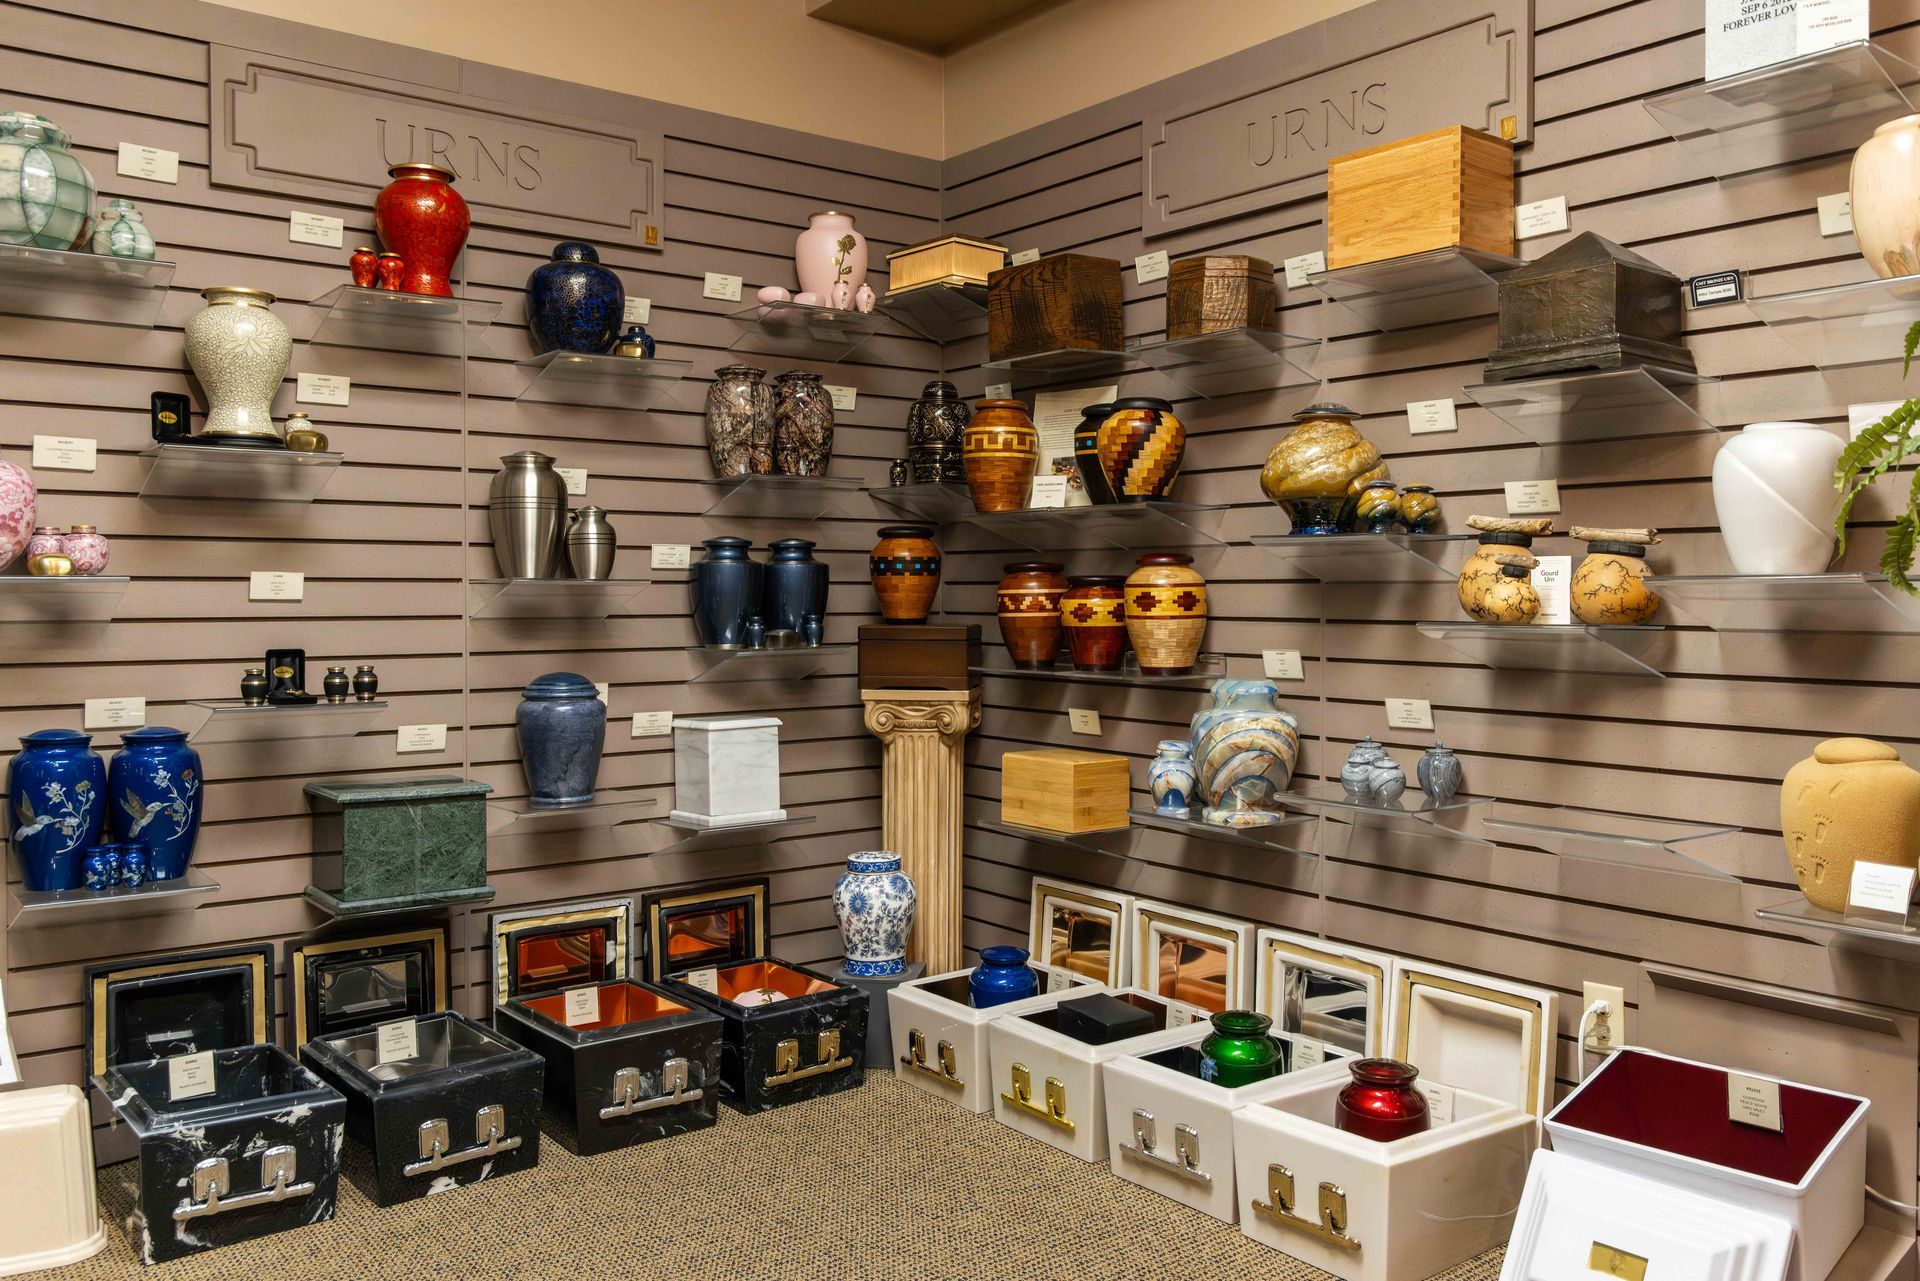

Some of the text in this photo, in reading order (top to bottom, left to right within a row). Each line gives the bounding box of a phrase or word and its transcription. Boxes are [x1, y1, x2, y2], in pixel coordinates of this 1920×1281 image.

[1723, 3, 1798, 32] FOREVER LOV
[1741, 3, 1760, 16] SEP
[1247, 82, 1388, 167] URNS
[375, 118, 543, 191] URNS
[1540, 569, 1559, 577] Gourd
